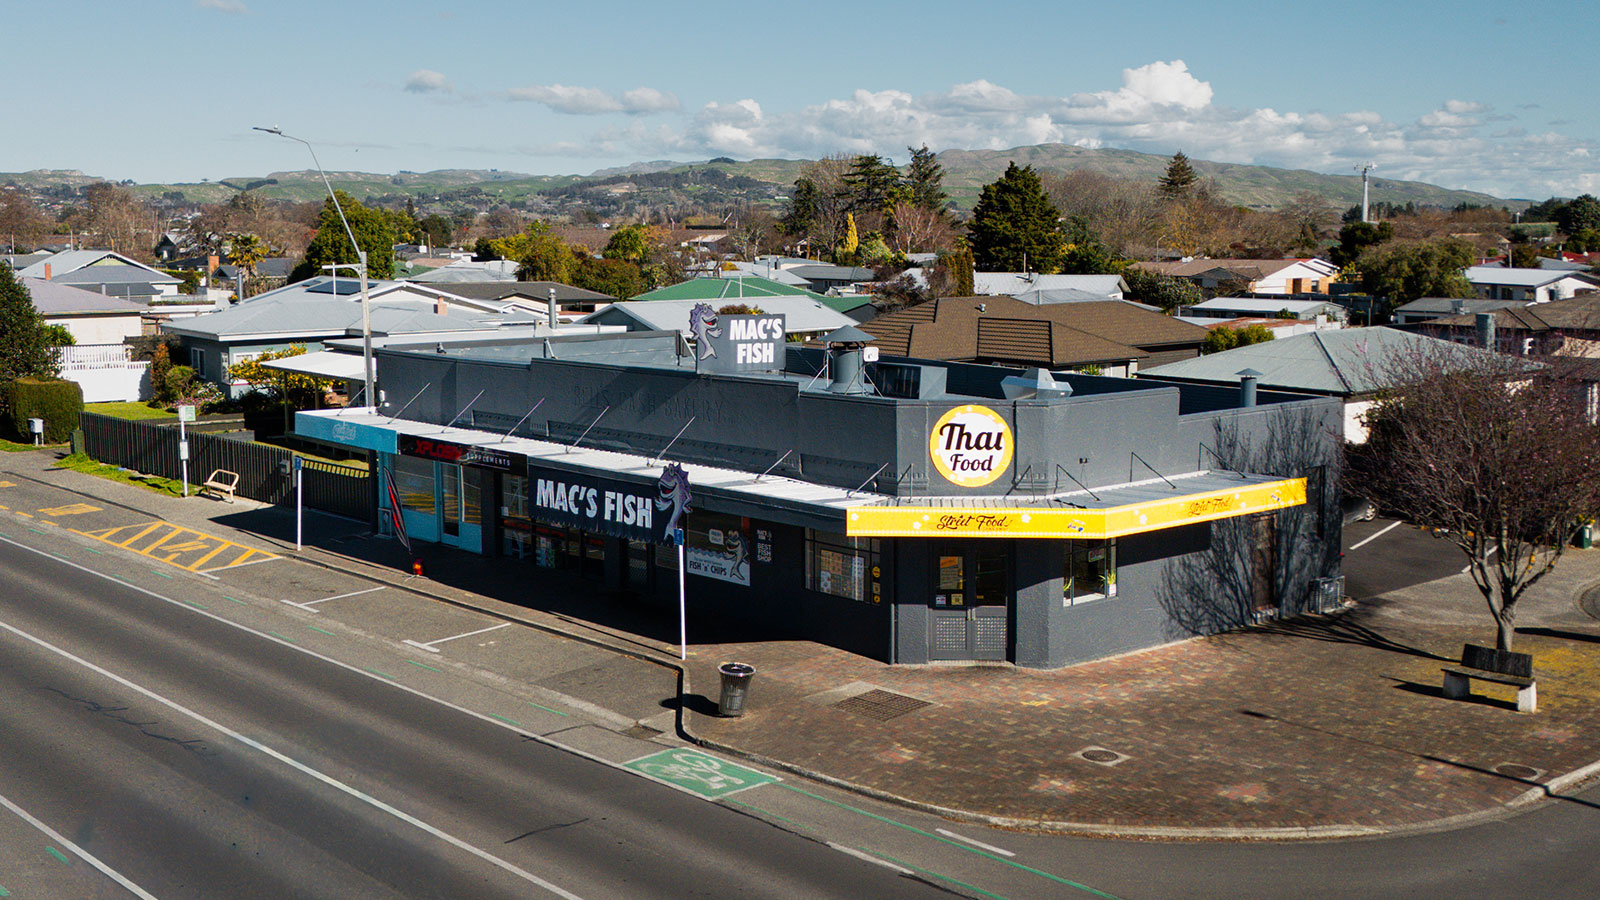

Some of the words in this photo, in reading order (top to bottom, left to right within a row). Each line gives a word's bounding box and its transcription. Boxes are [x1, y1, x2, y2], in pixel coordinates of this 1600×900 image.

[729, 318, 783, 340] MAC'S
[737, 342, 774, 364] FISH
[664, 396, 725, 424] BAKERY
[949, 453, 993, 471] Food
[536, 478, 598, 518] MAC'S
[604, 490, 652, 529] FISH
[936, 514, 976, 530] Street
[976, 514, 1009, 530] Food
[689, 560, 702, 570] FISH
[711, 565, 727, 576] CHIPS
